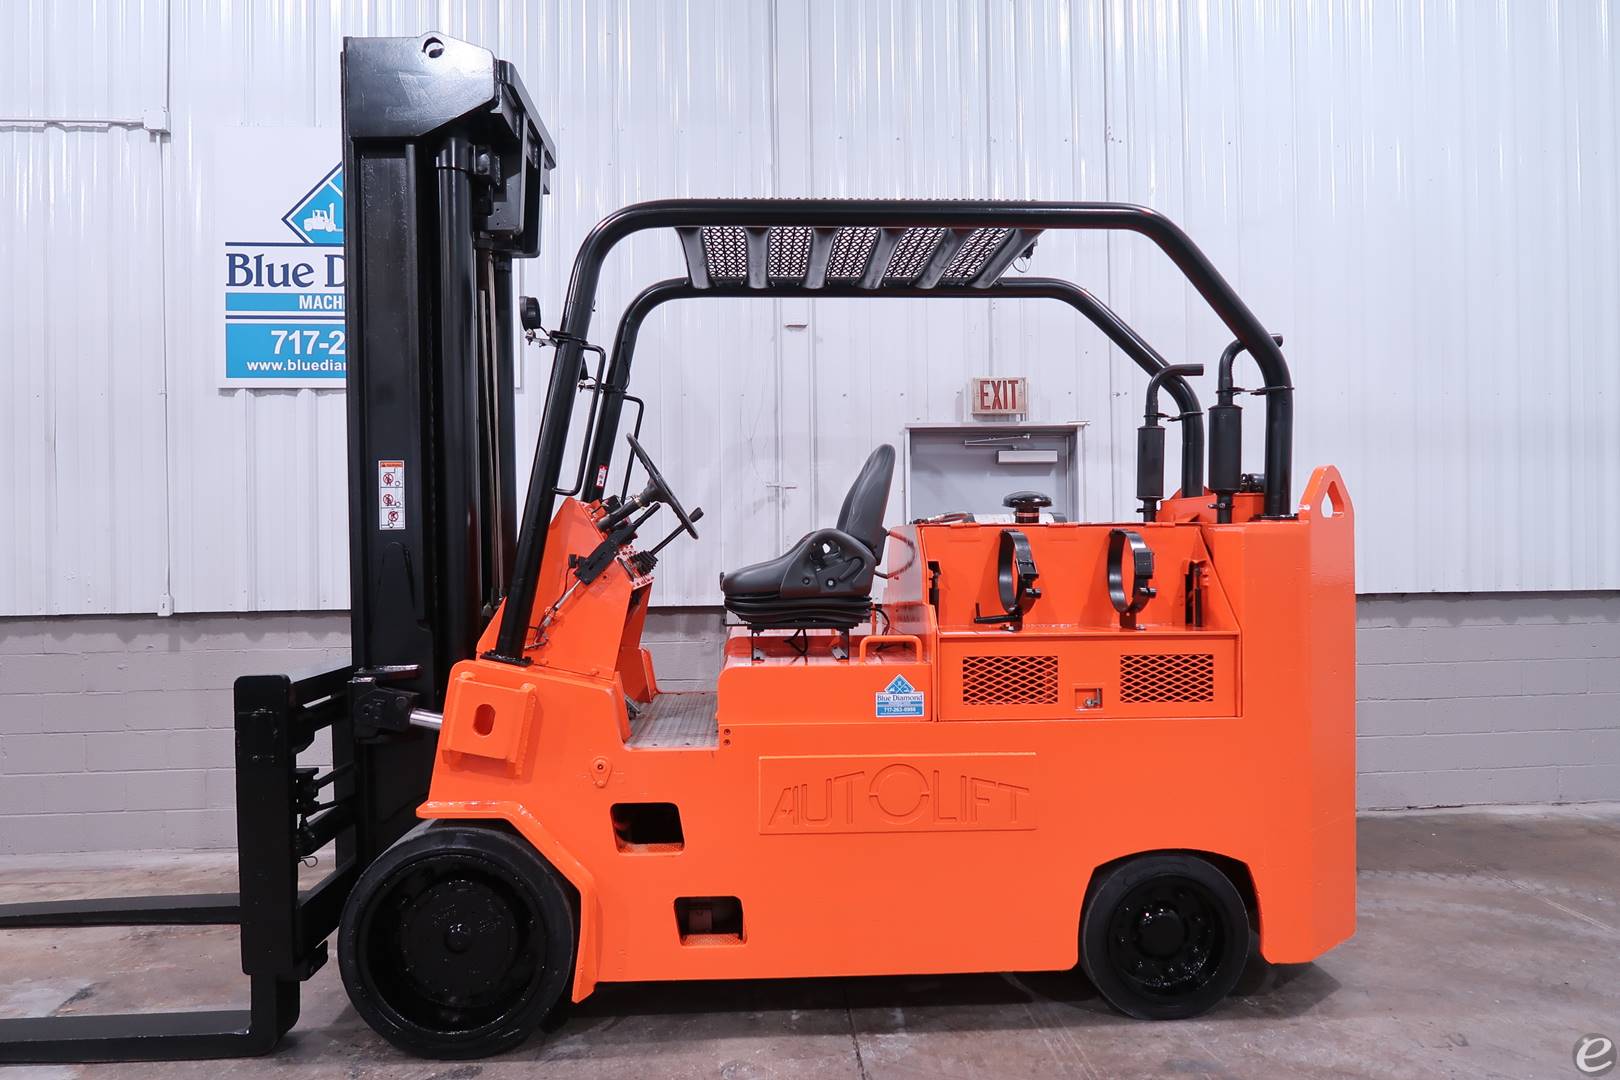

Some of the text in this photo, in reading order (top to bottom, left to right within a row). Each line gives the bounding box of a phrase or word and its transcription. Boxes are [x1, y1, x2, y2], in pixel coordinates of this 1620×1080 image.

[225, 253, 315, 288] Blue
[271, 330, 346, 355] 717-2
[980, 380, 1019, 410] EXIT
[877, 694, 923, 702] Blue Diamond
[767, 762, 1031, 827] AUTOLIFT
